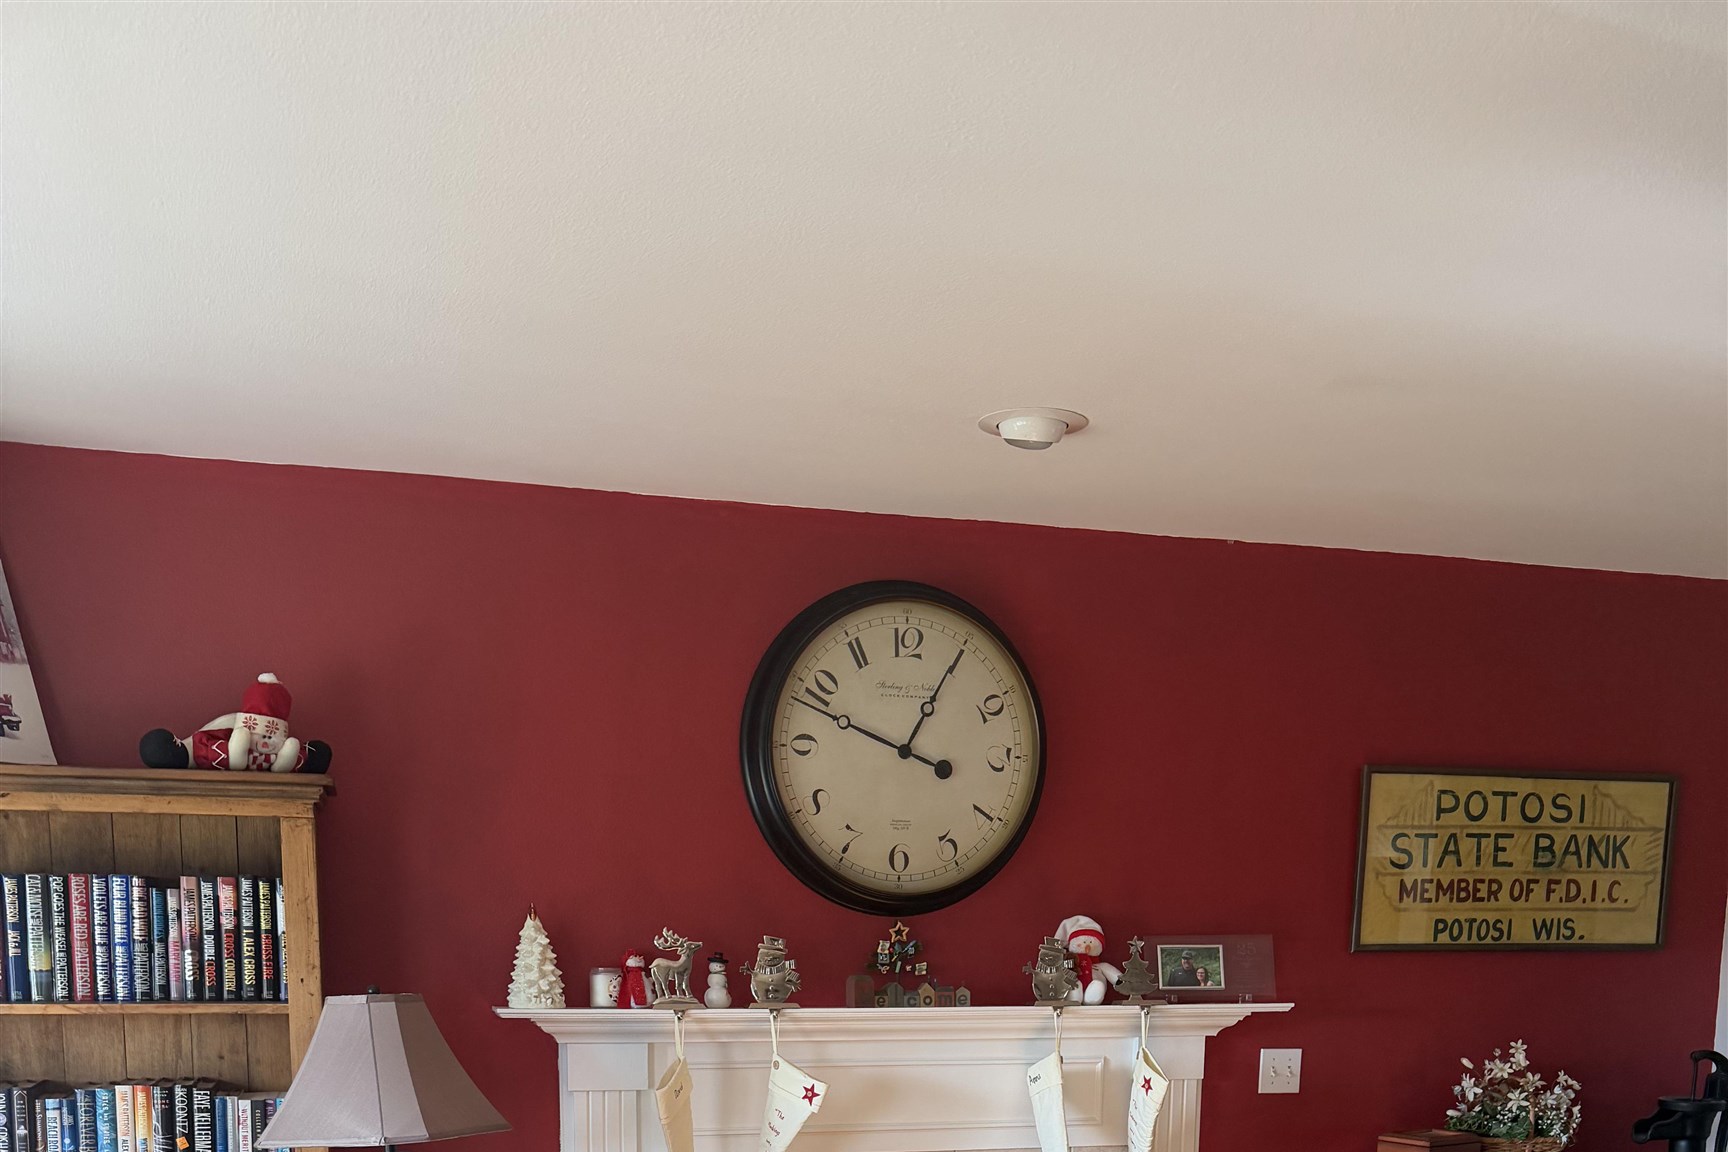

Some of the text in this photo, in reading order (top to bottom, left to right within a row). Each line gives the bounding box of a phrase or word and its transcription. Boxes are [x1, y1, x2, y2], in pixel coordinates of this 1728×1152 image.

[888, 627, 923, 660] 12
[802, 669, 838, 708] 10
[976, 694, 1004, 724] 2
[790, 734, 819, 760] 9
[986, 744, 1012, 772] 3
[802, 788, 830, 816] 8
[1436, 790, 1586, 823] POTOSI
[972, 804, 996, 830] 4
[838, 824, 863, 854] 7
[936, 829, 958, 862] 5
[1389, 833, 1631, 869] STATE BANK
[888, 843, 911, 873] 6
[6, 878, 18, 894] JAMES
[52, 876, 63, 892] POP
[72, 876, 86, 903] ROSES
[94, 878, 107, 910] VIOLETS
[113, 878, 126, 898] FOUR
[132, 887, 146, 900] BIG
[242, 878, 252, 897] JAMES
[1399, 878, 1629, 904] MEMBER OF F.D.I.C.
[6, 895, 19, 922] PATTERSON
[28, 894, 43, 918] MOUSE
[54, 893, 64, 911] GOES
[74, 905, 86, 920] ARE
[114, 900, 128, 922] BLIND
[133, 901, 147, 918] BAD
[242, 897, 254, 926] PATTERSON
[54, 912, 65, 926] THE
[74, 924, 88, 938] RED
[94, 910, 107, 926] ARE
[134, 918, 148, 941] WOLF
[260, 881, 274, 980] JAMES PATTERSON CROSS FIRE
[1433, 918, 1585, 942] POTOSI WIS.
[8, 930, 20, 942] JACK
[55, 927, 66, 952] WEASEL
[95, 926, 108, 944] BLUE
[114, 924, 128, 944] MICE
[184, 888, 200, 981] JAMES PATTERSON CROSS
[202, 882, 216, 986] JAMES PATTERSON DOUBLE CROSS
[223, 885, 236, 992] JAMES PATTERSON CROSS COUNTRY
[244, 937, 255, 956] ALEX
[156, 942, 165, 958] JAMES
[170, 940, 179, 961] MARY
[58, 958, 69, 996] PATTERSON
[76, 948, 90, 996] PATTERSON
[96, 952, 110, 995] PATTERSON
[116, 952, 130, 996] PATTERSON
[134, 952, 150, 992] PATTERSON
[156, 958, 166, 984] PATTERSON
[170, 962, 180, 982] MARY
[244, 958, 256, 984] CROSS
[176, 1092, 188, 1134] KOONTZ
[194, 1090, 210, 1110] FAYE
[48, 1116, 58, 1138] BEACH
[77, 1102, 96, 1145] FOREVER
[122, 1138, 130, 1152] ALEX
